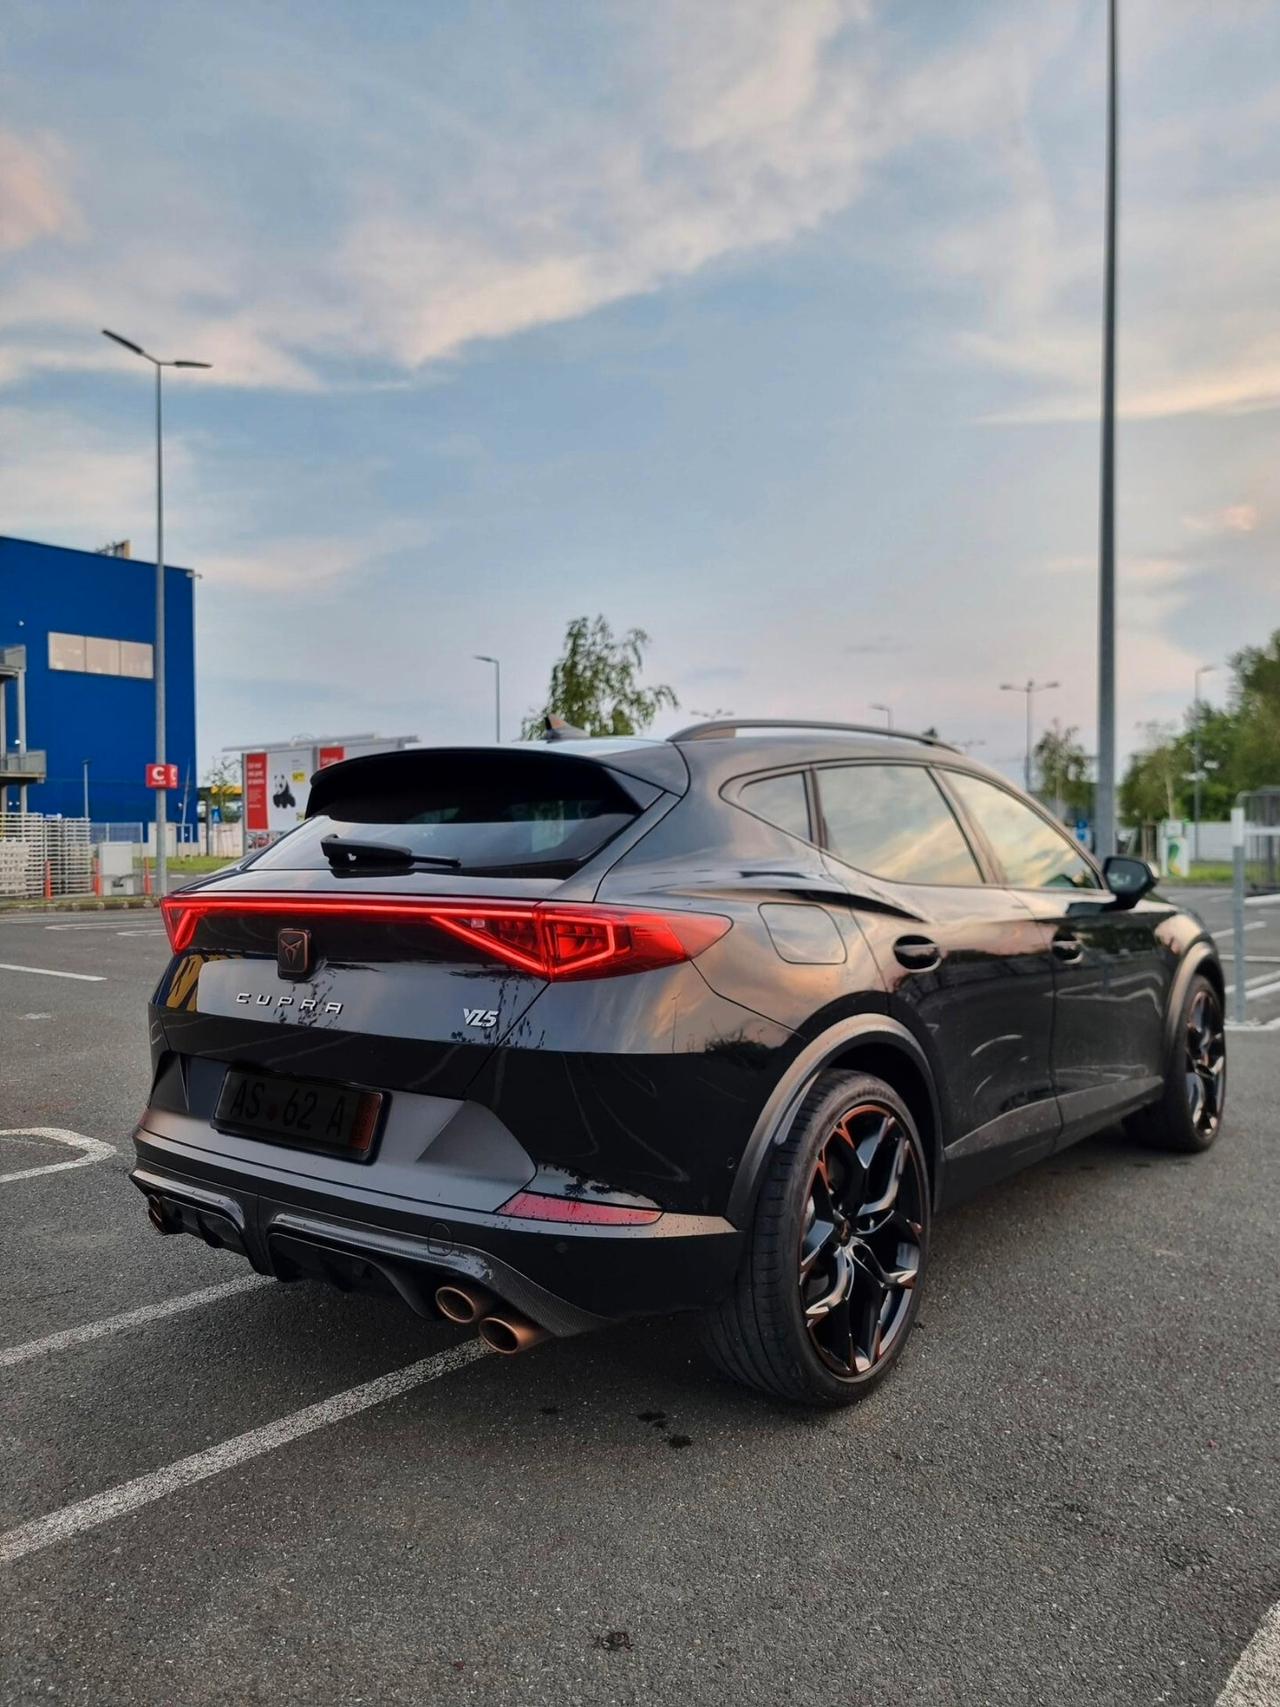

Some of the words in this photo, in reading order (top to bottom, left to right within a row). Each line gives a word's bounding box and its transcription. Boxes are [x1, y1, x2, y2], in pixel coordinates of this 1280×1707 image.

[152, 766, 165, 780] C
[236, 993, 343, 1013] CUPRA
[463, 1008, 499, 1026] VZ5
[230, 1079, 265, 1119] AS
[283, 1088, 318, 1130] 62
[326, 1095, 345, 1137] A
